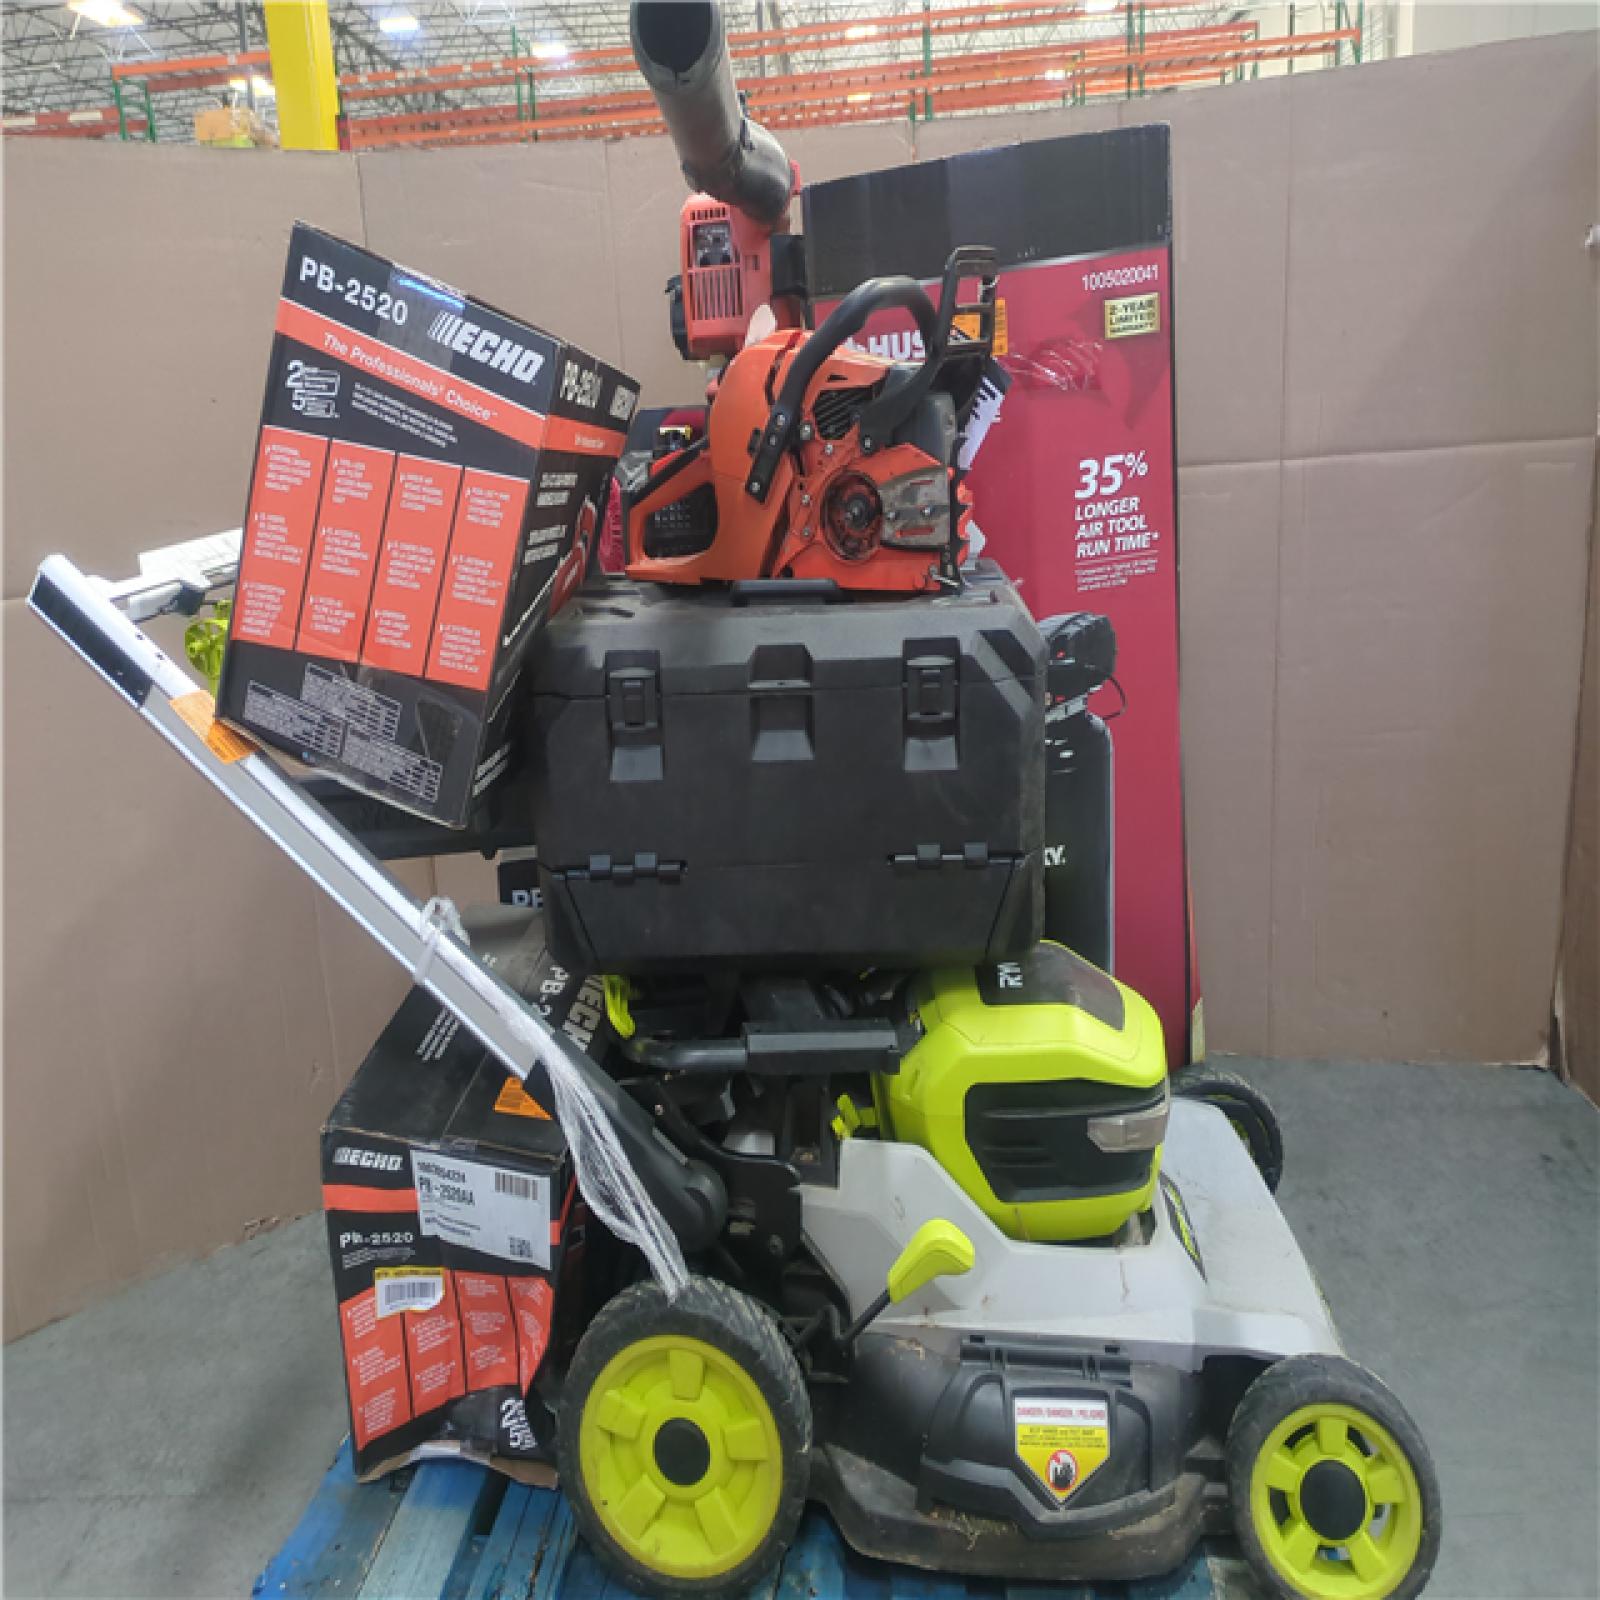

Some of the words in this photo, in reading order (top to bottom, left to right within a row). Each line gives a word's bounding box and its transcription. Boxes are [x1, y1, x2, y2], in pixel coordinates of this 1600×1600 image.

[1082, 265, 1159, 291] 1005020041
[299, 255, 409, 326] PB-2520
[442, 319, 547, 385] ECHO
[324, 331, 348, 356] The
[350, 346, 446, 397] Professionals'
[1074, 449, 1149, 499] 35%
[1074, 496, 1141, 521] LONGER
[1074, 521, 1104, 541] AIR
[1107, 514, 1148, 535] TOOL
[1076, 539, 1111, 559] RUN
